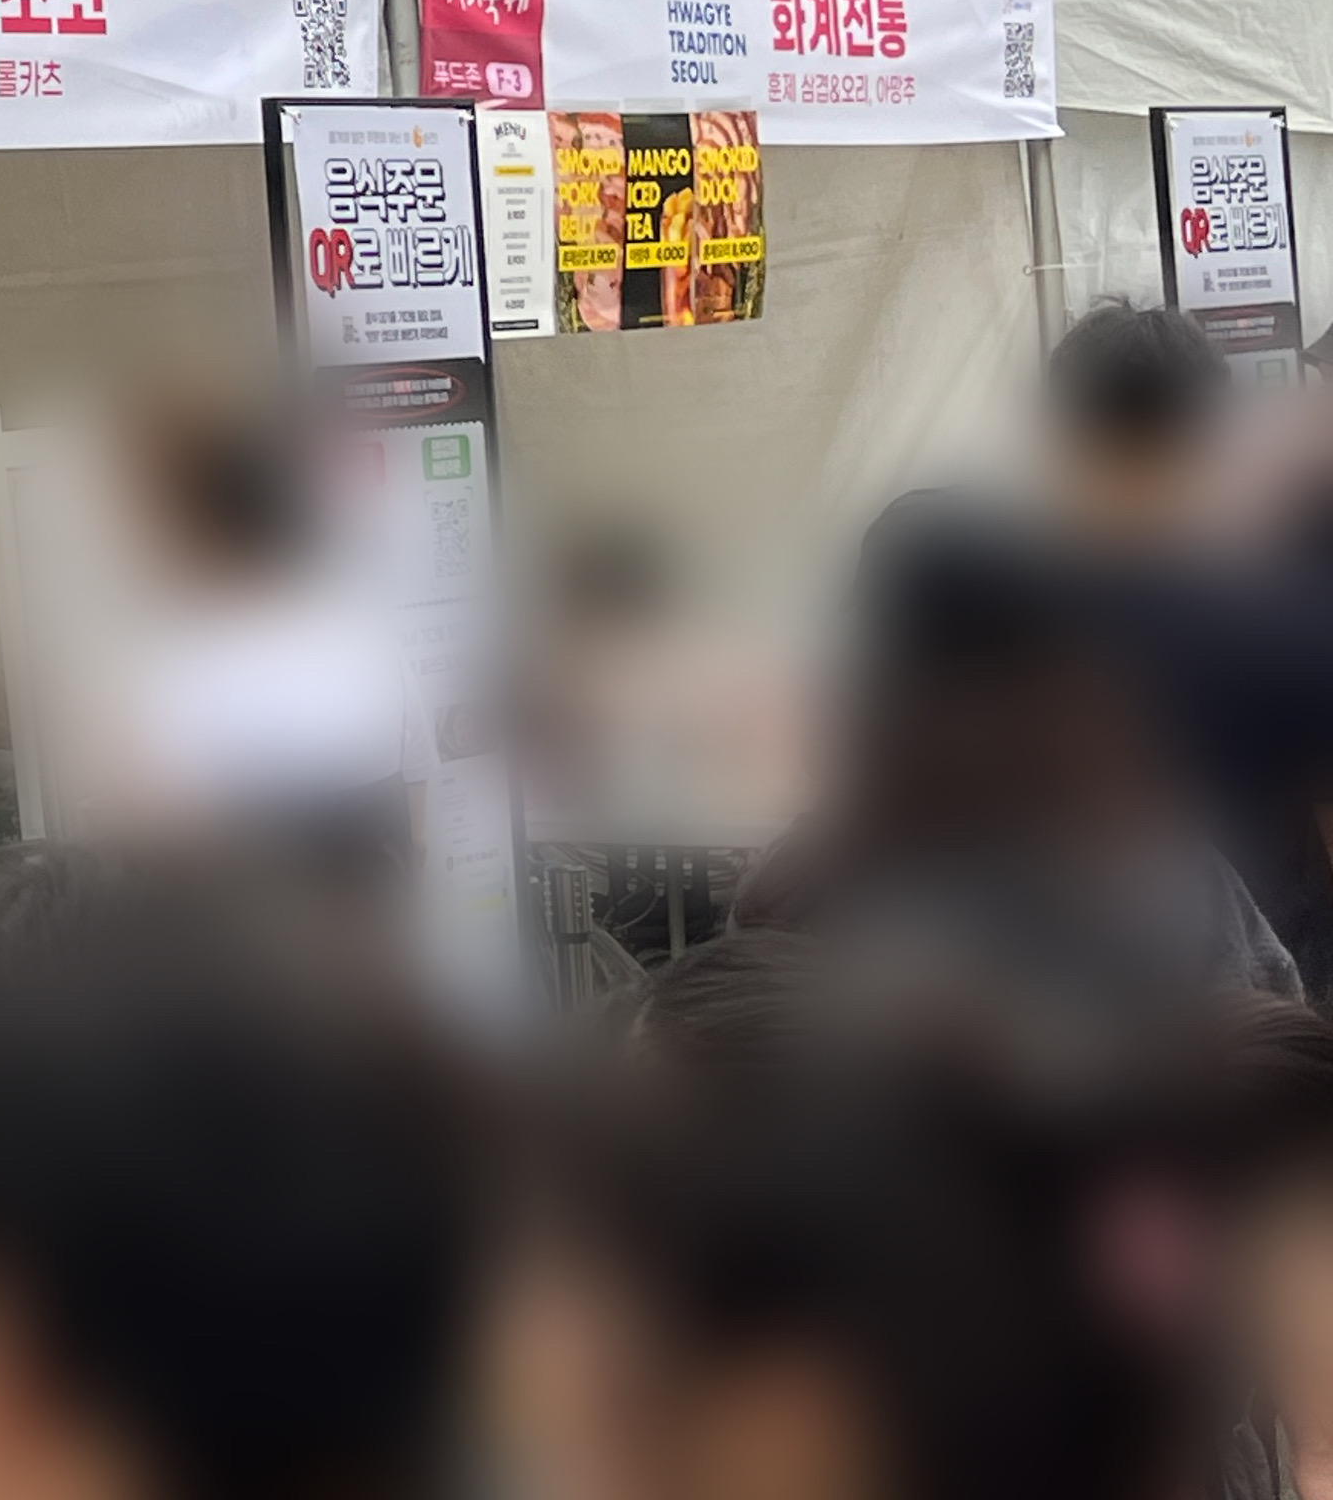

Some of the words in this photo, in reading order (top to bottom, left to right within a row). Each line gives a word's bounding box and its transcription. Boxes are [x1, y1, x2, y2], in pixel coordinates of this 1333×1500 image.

[667, 0, 732, 27] HWAGYE
[669, 30, 747, 56] TRADITION
[434, 60, 482, 90] 푸드존
[496, 67, 523, 92] F-3
[671, 60, 718, 84] SEOUL
[768, 72, 796, 103] 훈제
[876, 74, 916, 105] 아망추
[494, 121, 526, 141] MENU
[555, 148, 621, 176] SMOKED
[627, 148, 691, 177] MANGO
[697, 145, 758, 175] SMOKED
[324, 157, 446, 223] 음식주문
[558, 181, 602, 209] PORK
[627, 181, 661, 208] ICED
[698, 179, 739, 206] DUCK
[625, 213, 654, 240] TEA
[309, 227, 384, 299] QR로
[386, 225, 474, 289] 빠르게
